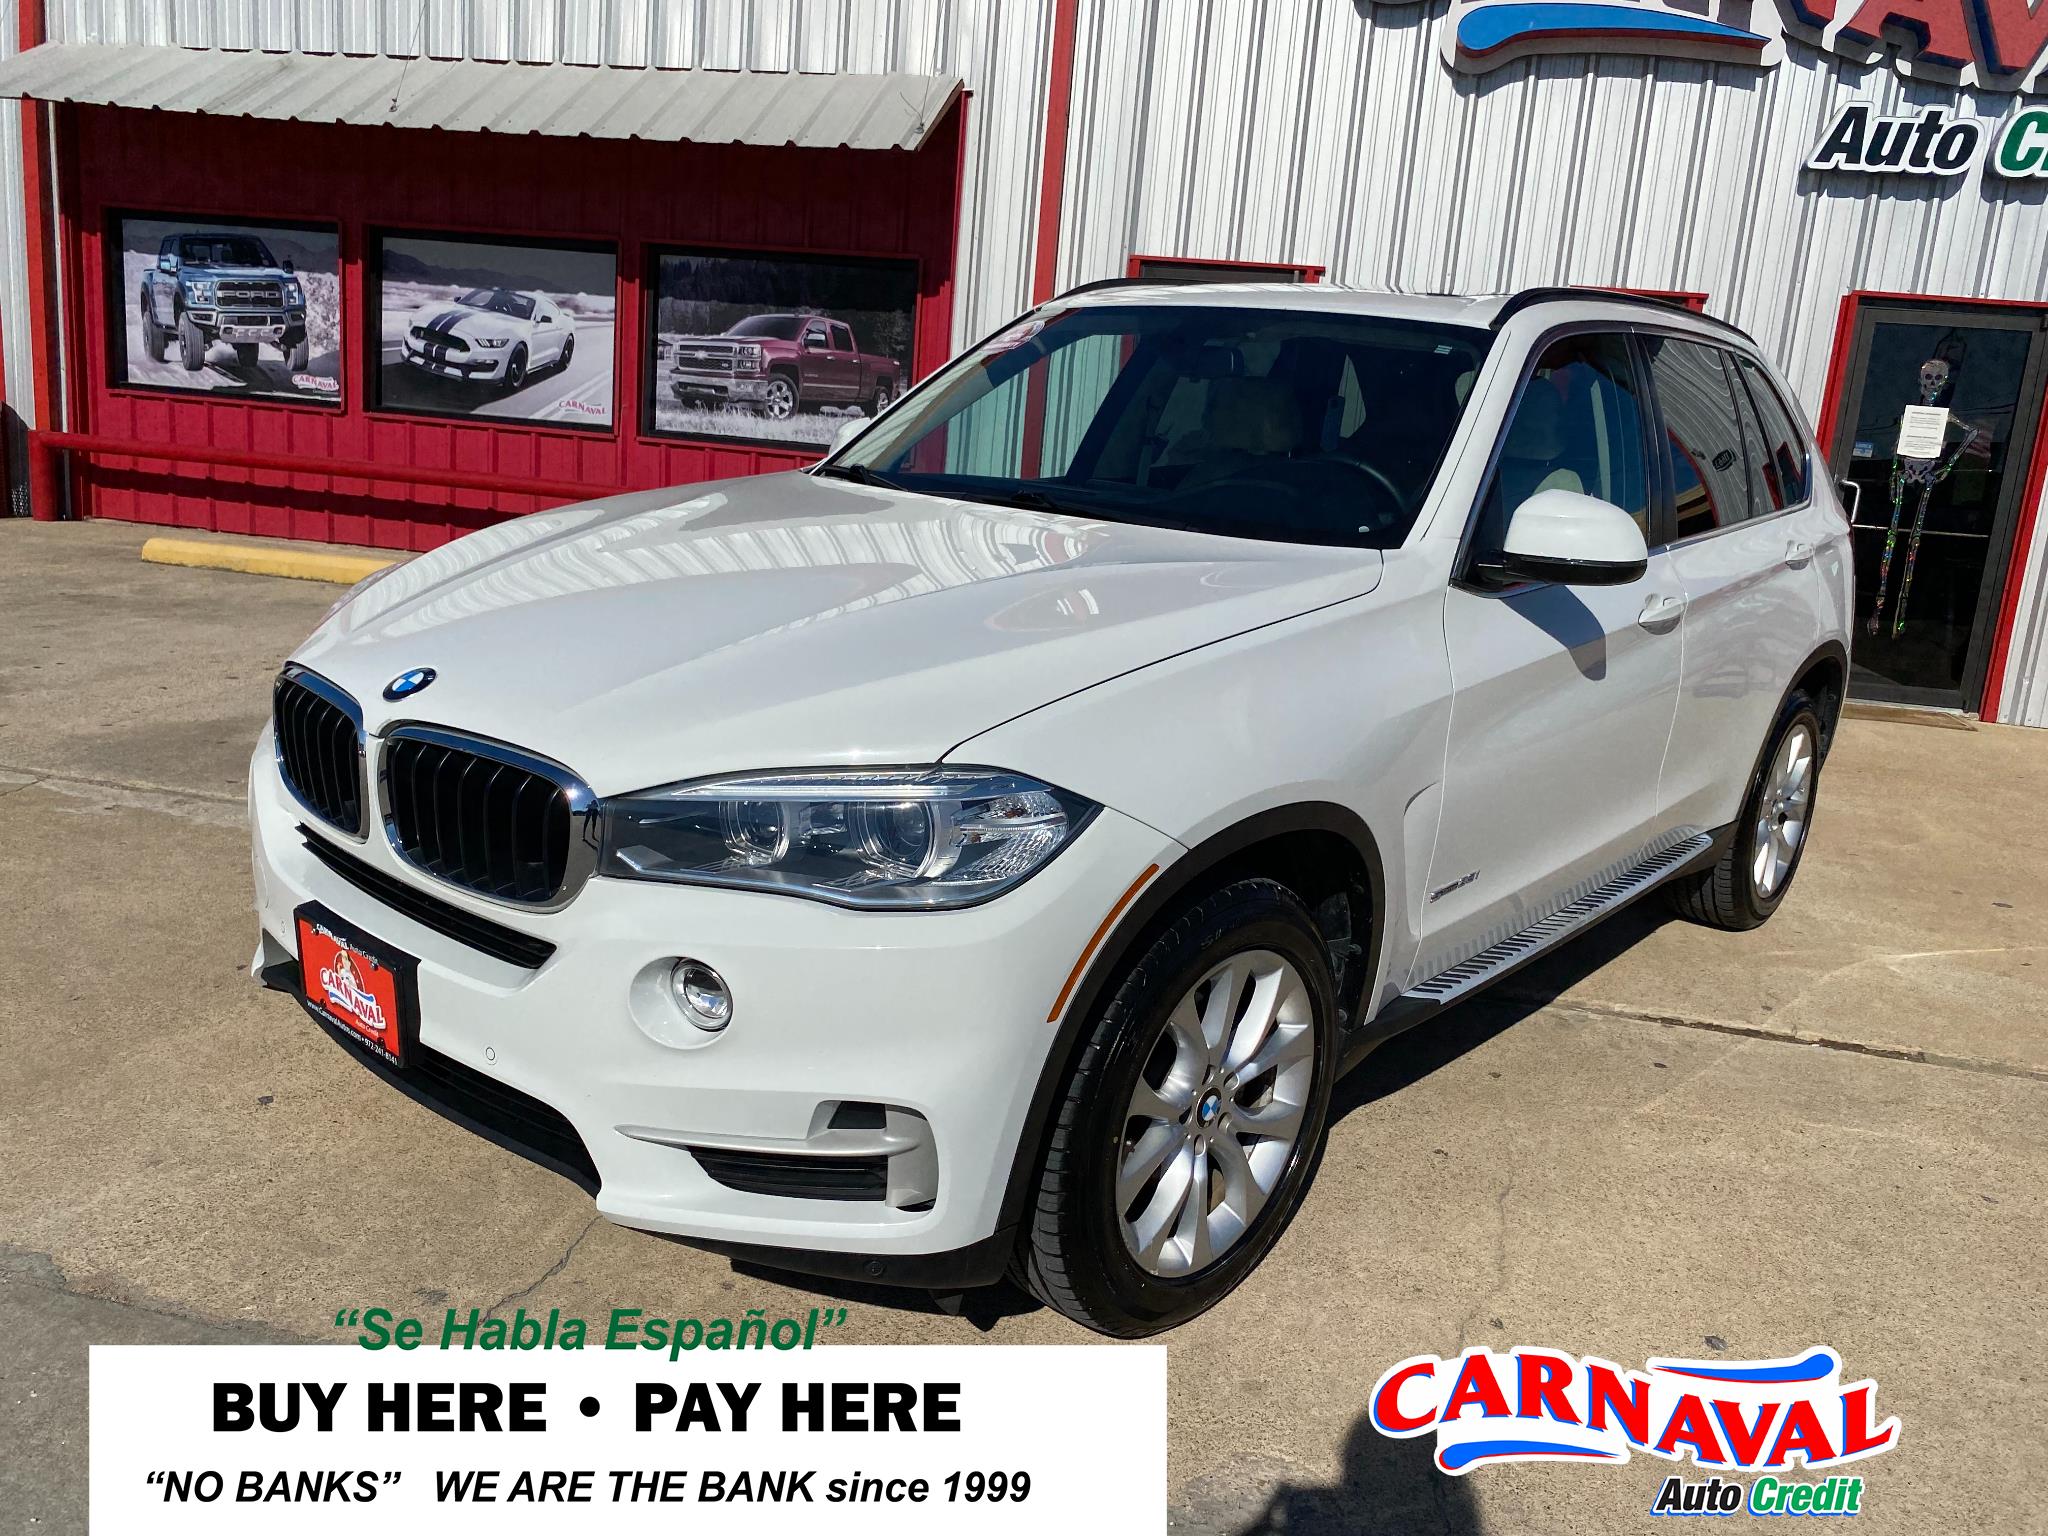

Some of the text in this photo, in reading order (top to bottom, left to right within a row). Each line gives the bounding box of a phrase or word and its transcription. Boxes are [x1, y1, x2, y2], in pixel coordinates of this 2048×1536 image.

[1814, 106, 2048, 171] Auto C
[220, 290, 280, 299] FORD
[293, 375, 339, 390] CARNAVAL
[559, 399, 607, 415] CARNAVAL
[320, 969, 385, 1025] CARNAVAL
